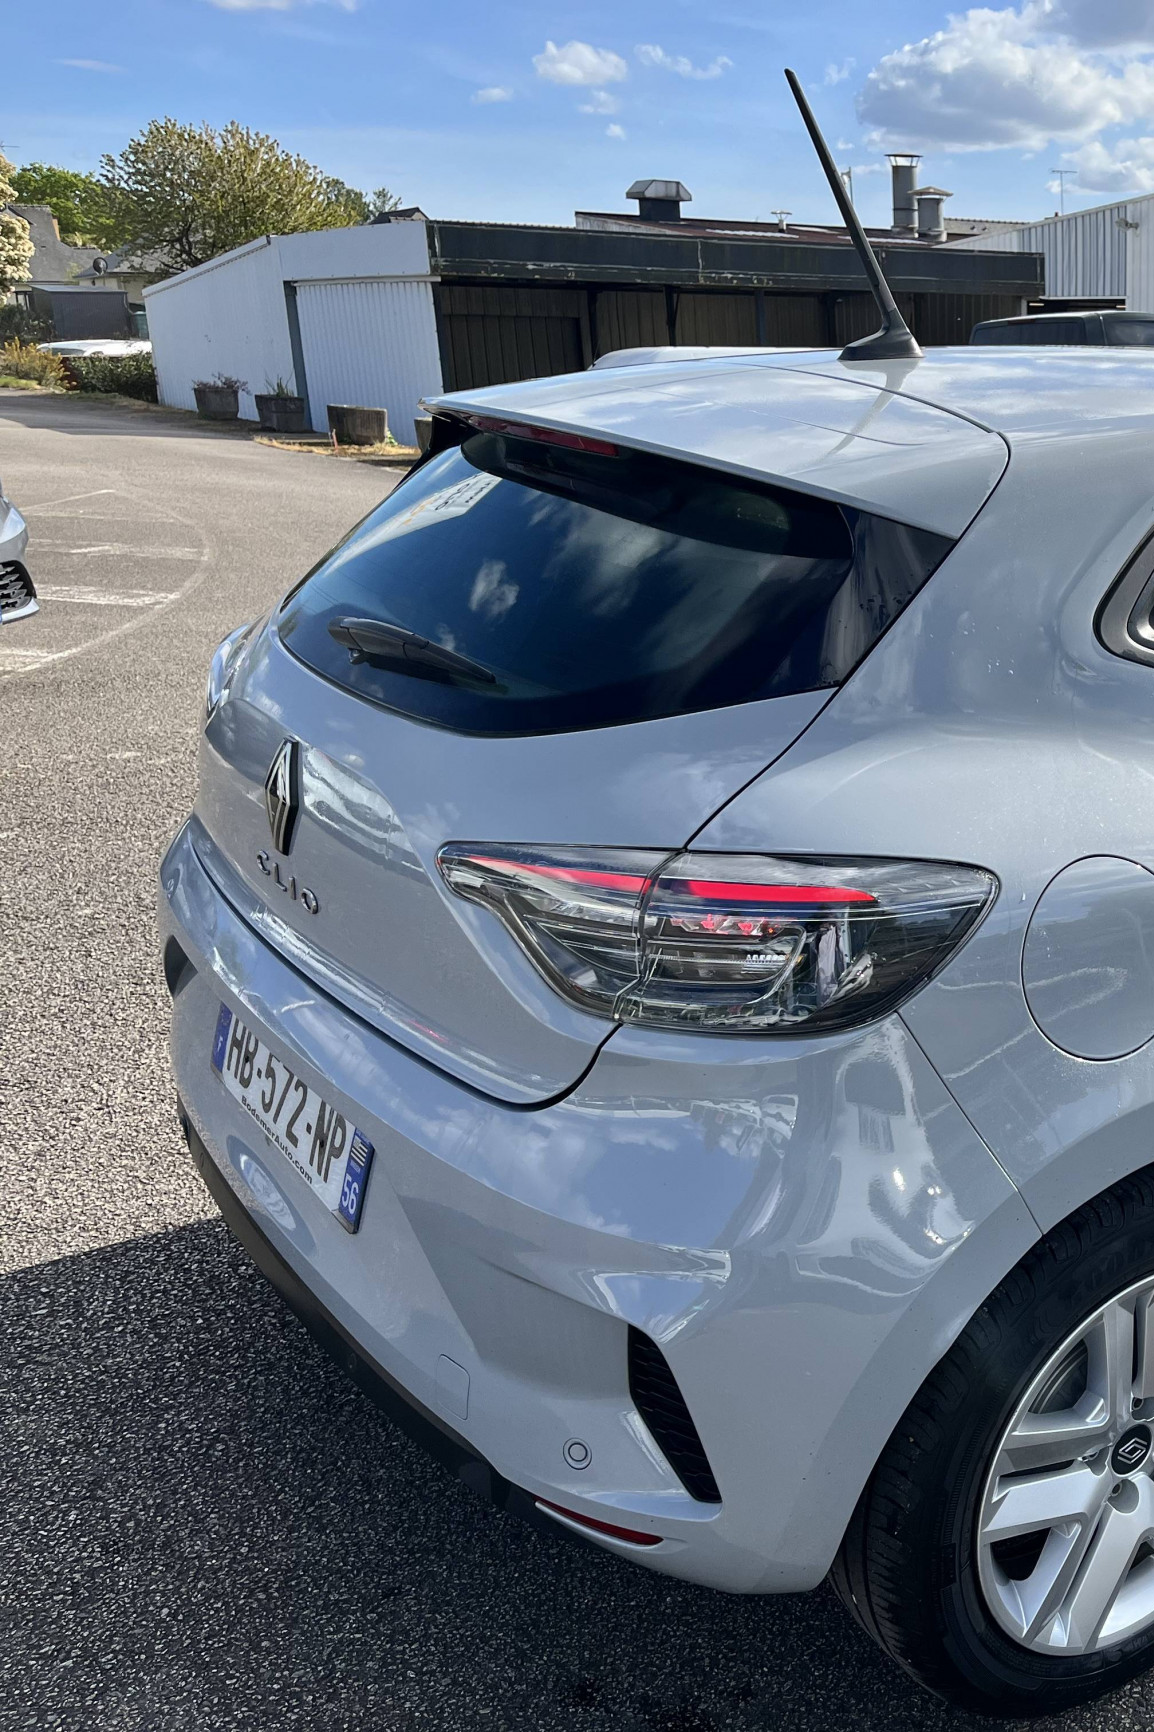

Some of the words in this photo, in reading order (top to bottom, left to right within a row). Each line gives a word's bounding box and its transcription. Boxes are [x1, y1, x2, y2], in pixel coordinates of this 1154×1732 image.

[257, 850, 319, 914] CLIO
[226, 1018, 347, 1183] HB-572-NP
[241, 1095, 313, 1184] BodemerAuto.com
[341, 1173, 359, 1215] 56
